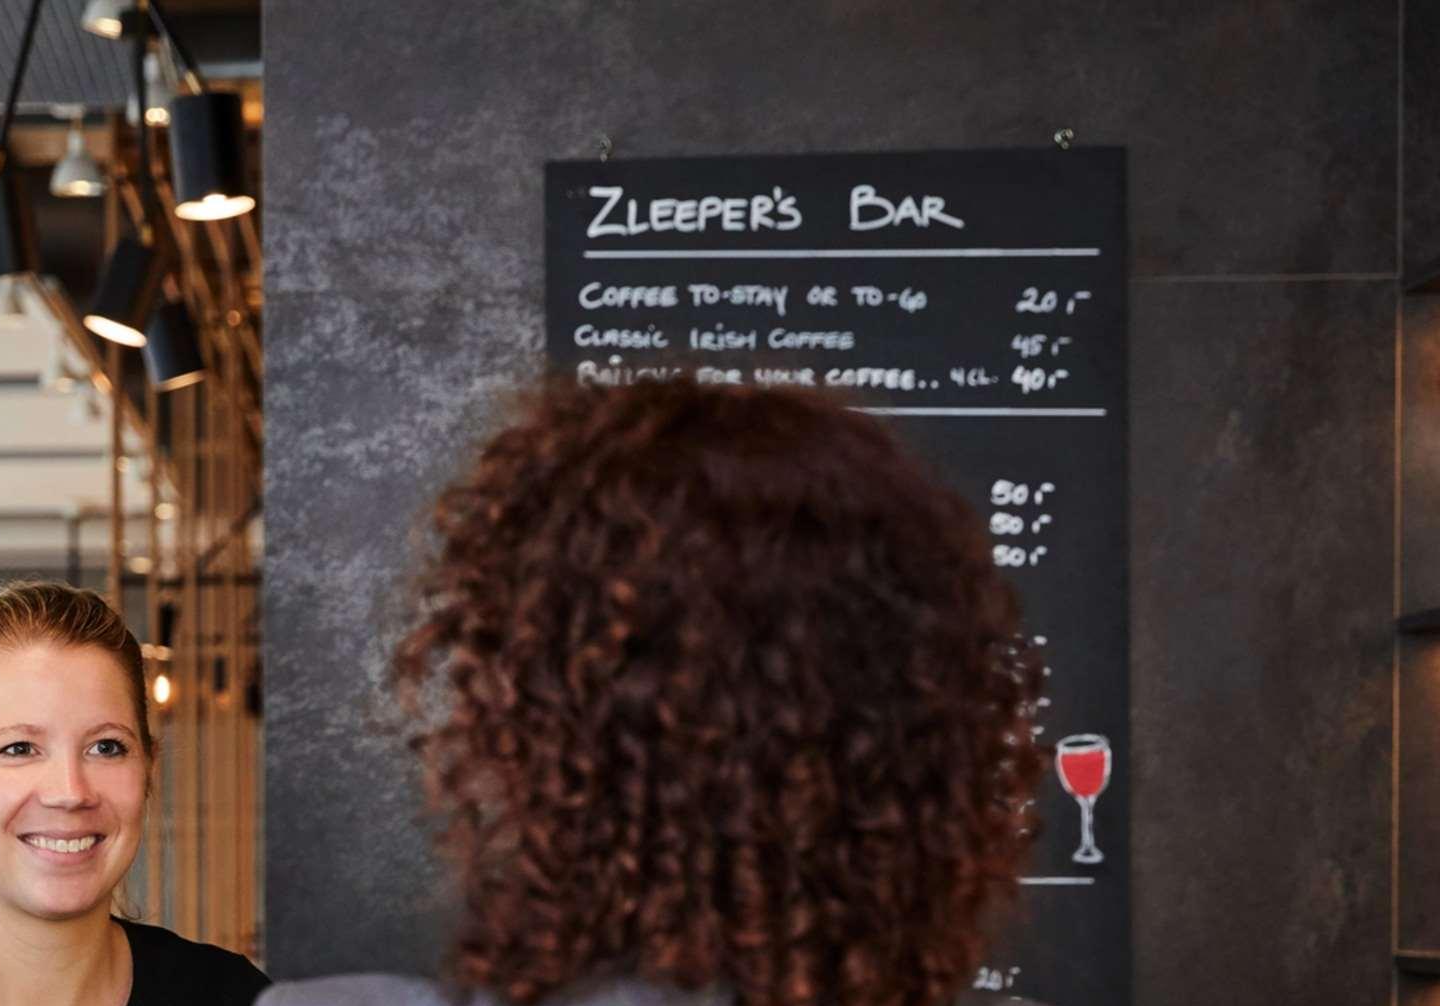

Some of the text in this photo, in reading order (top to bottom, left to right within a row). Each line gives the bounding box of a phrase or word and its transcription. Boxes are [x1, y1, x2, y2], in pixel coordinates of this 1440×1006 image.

[587, 184, 965, 238] ZLEEPER'S BAR
[578, 282, 678, 309] COFFEE
[688, 283, 788, 317] TO-STAY
[807, 285, 838, 306] OR
[768, 327, 854, 350] COFFEE
[696, 366, 743, 385] FOR
